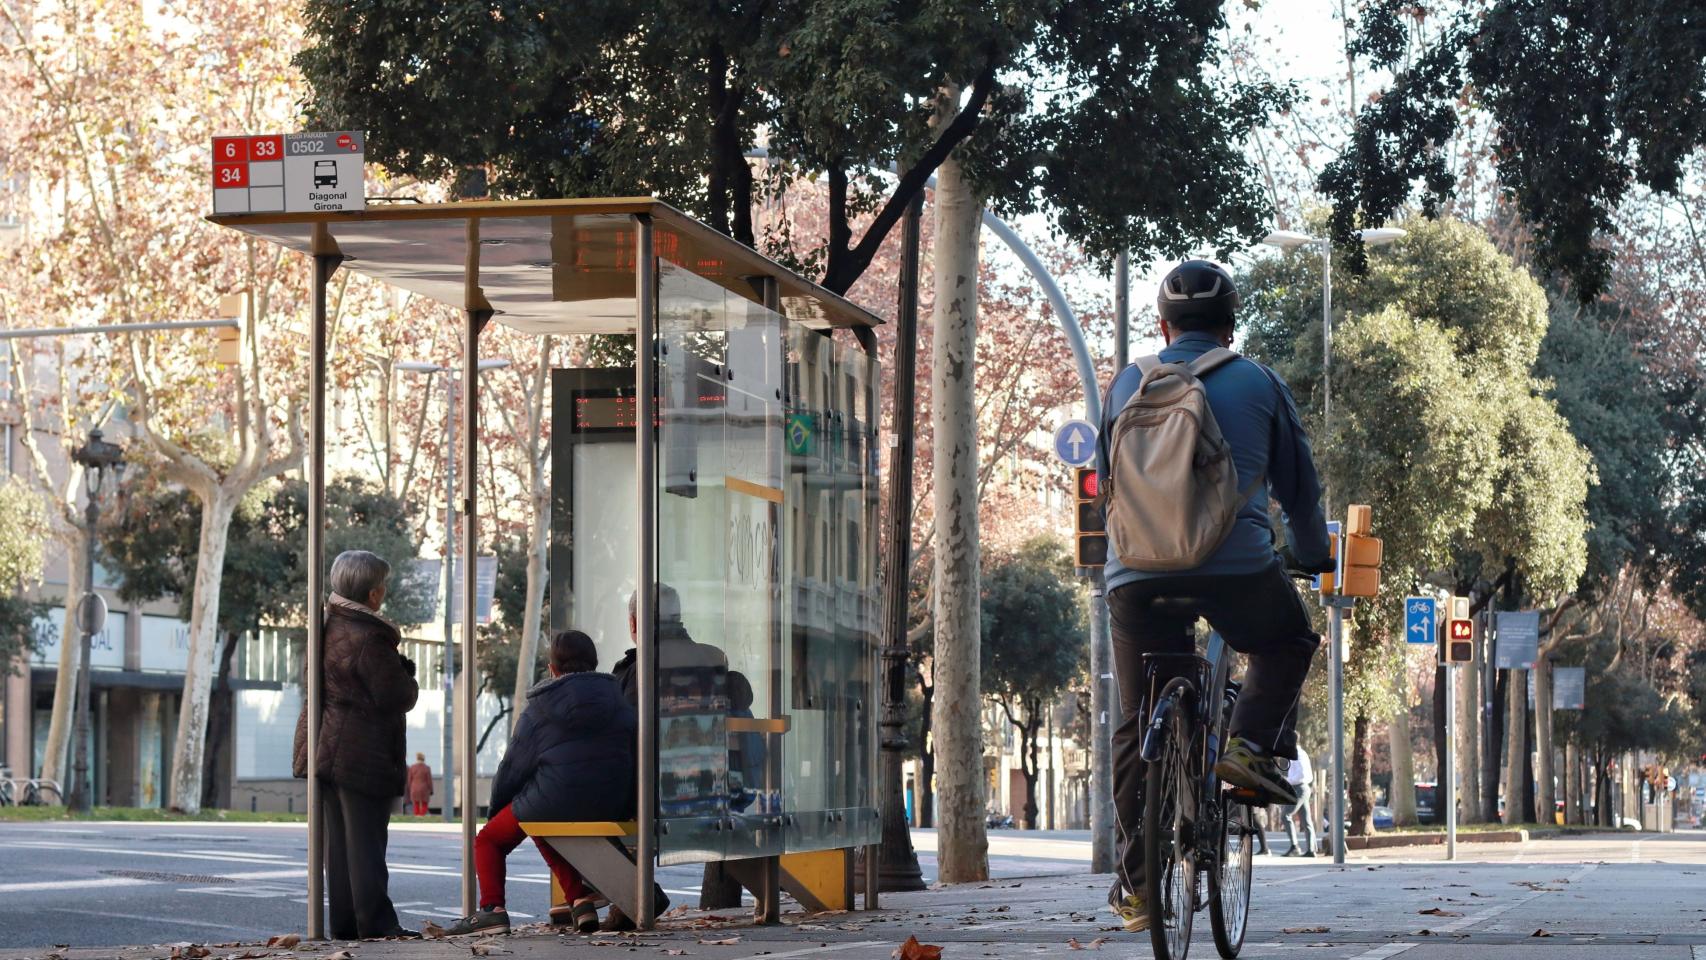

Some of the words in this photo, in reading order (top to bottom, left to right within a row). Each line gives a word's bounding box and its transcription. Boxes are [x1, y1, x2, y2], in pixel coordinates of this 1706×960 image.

[225, 143, 236, 157] 6
[256, 141, 276, 155] 33
[291, 140, 324, 153] 0502
[221, 168, 241, 182] 34
[309, 192, 347, 201] Diagonal
[314, 202, 342, 210] Girona
